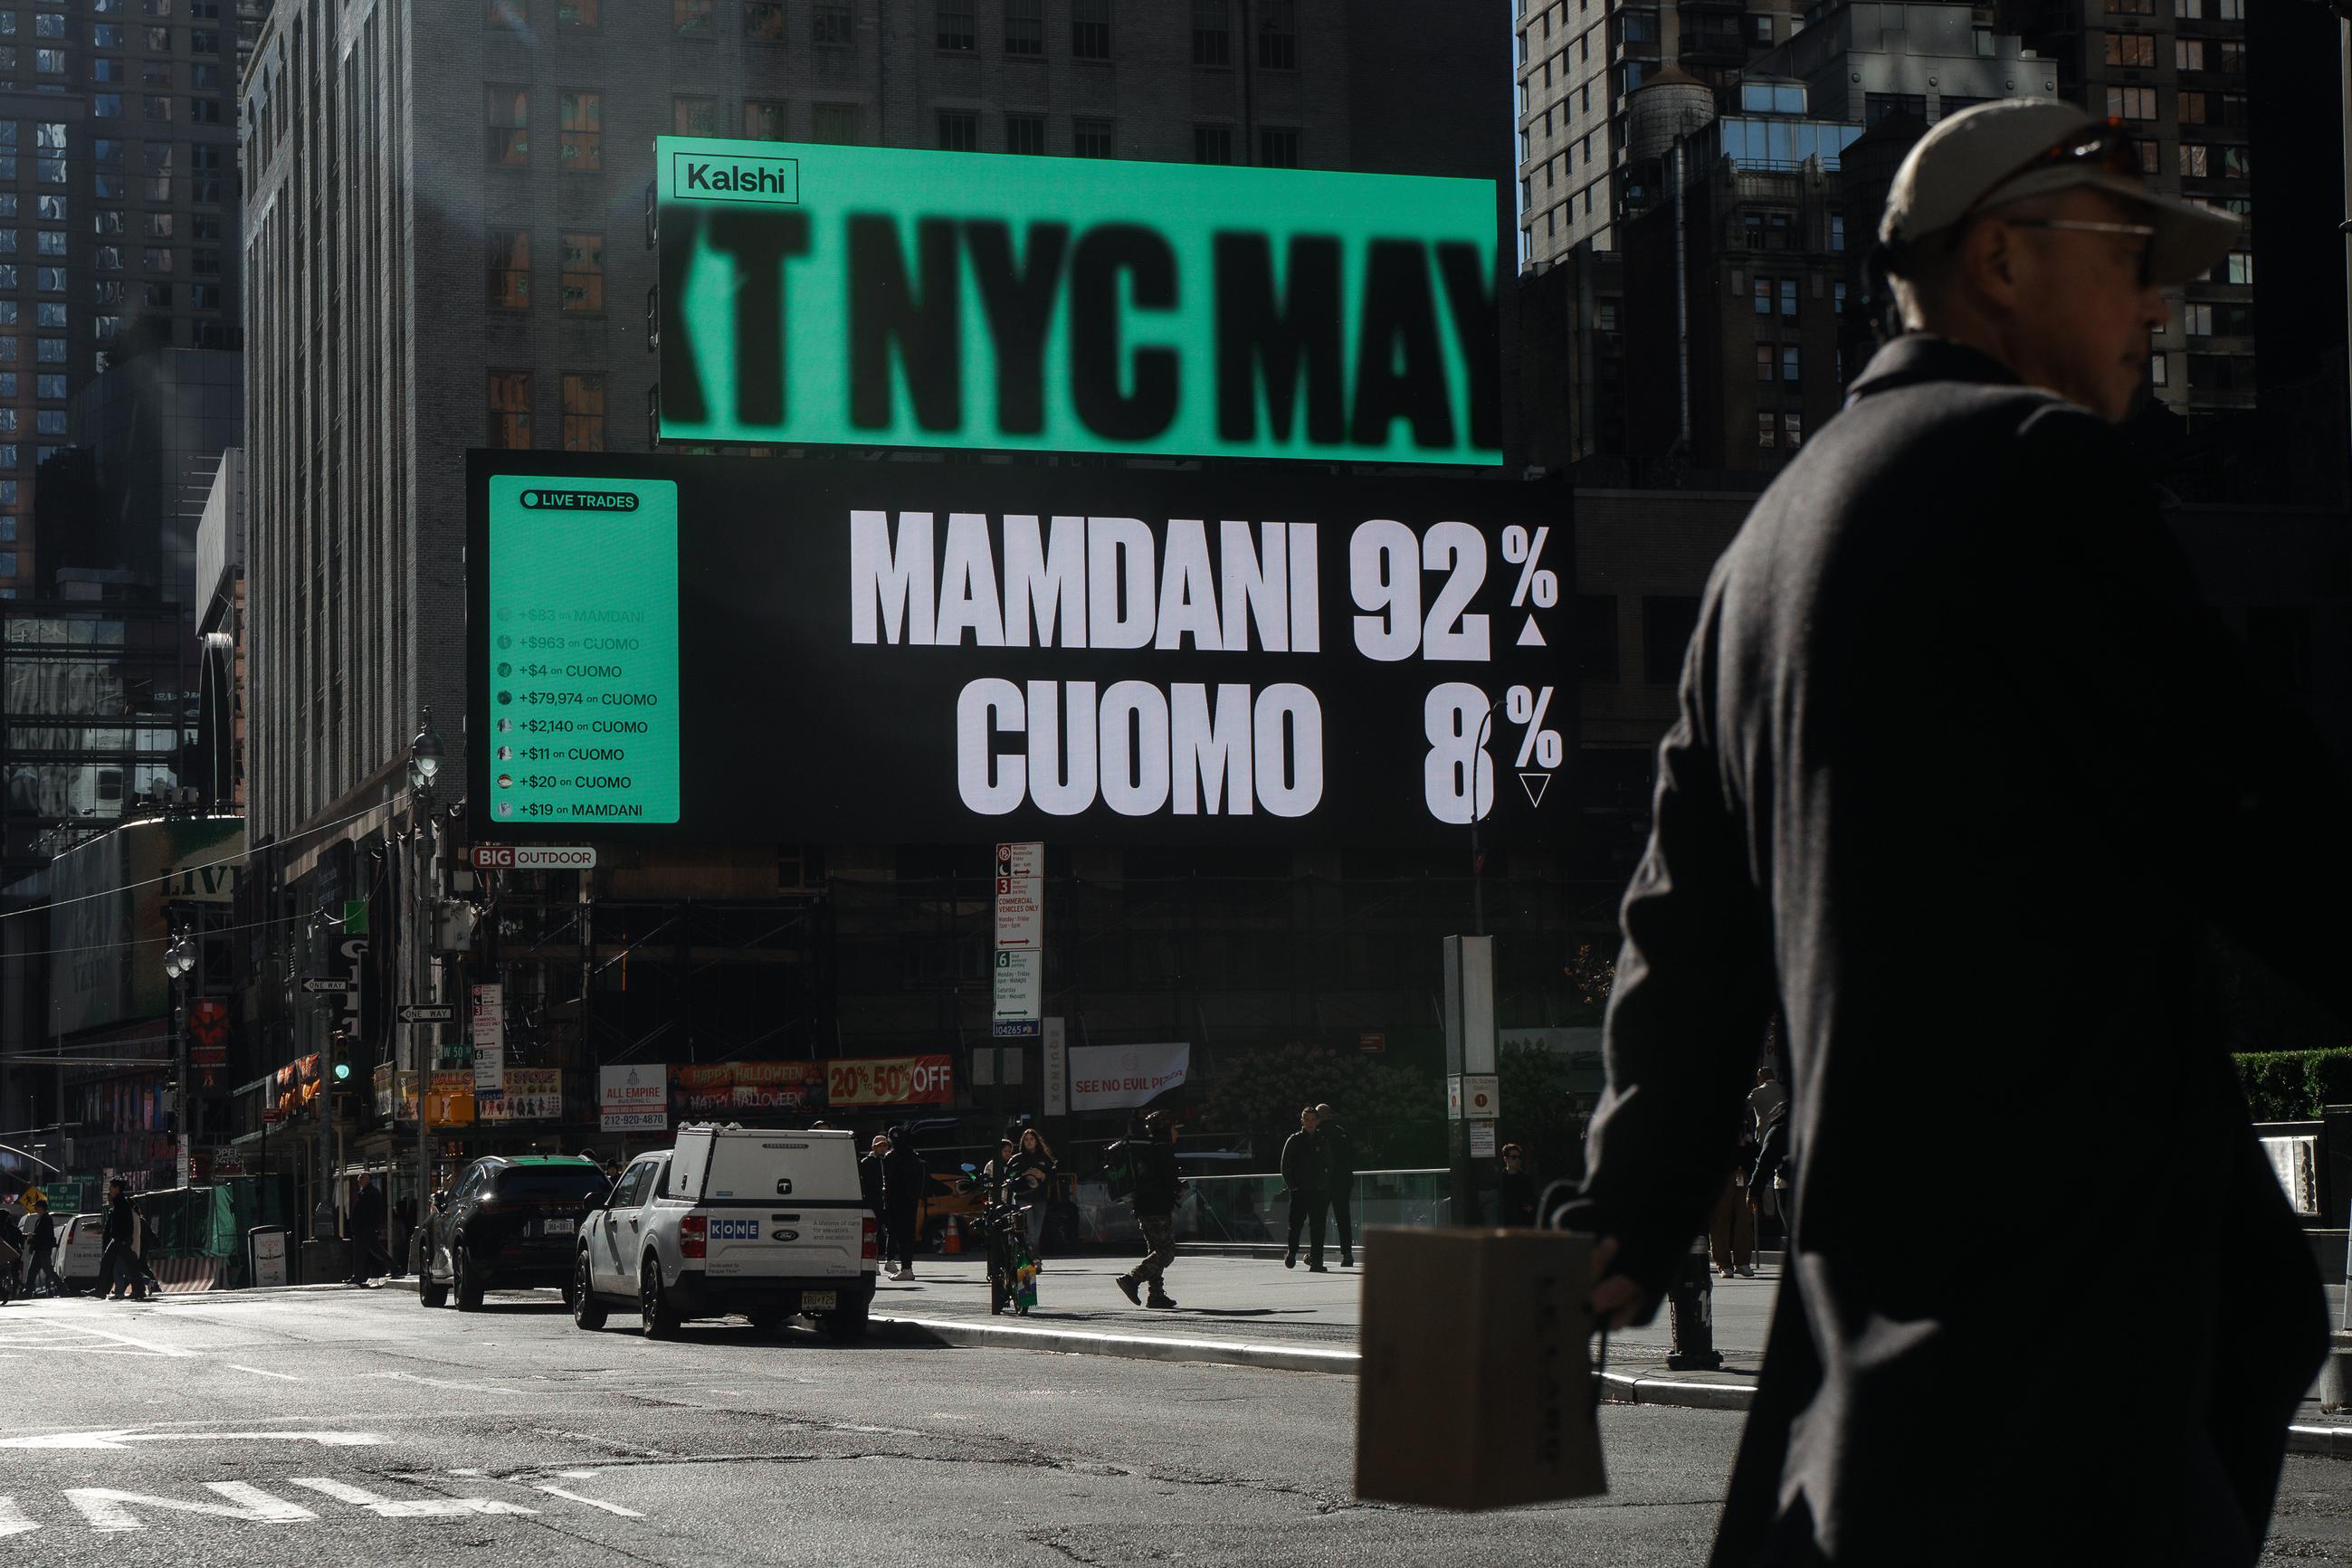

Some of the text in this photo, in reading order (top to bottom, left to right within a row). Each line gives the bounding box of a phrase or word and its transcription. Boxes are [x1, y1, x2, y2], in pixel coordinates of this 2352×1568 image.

[688, 163, 785, 194] Kalshi
[848, 210, 1181, 443] NYC
[543, 494, 634, 508] LIVE TRADES
[851, 510, 1320, 652] MAMDANI
[519, 609, 555, 622] +$83
[574, 611, 644, 622] MAMDANI
[519, 636, 565, 649] +$963
[584, 638, 639, 651] CUOMO
[519, 663, 548, 678] +$4
[567, 665, 622, 678] CUOMO
[519, 691, 583, 706] +$79,974
[602, 694, 657, 706] CUOMO
[519, 718, 573, 734] +$2,140
[592, 721, 648, 733] CUOMO
[519, 746, 549, 761] +$11
[568, 748, 624, 760] CUOMO
[957, 678, 1323, 817] CUOMO
[519, 774, 557, 789] +$20
[575, 775, 631, 788] CUOMO
[520, 802, 553, 816] +$19
[572, 804, 642, 816] MAMDANI
[480, 851, 592, 865] BIG OUTDOOR
[1000, 879, 1008, 893] 3
[999, 953, 1007, 967] 6
[309, 981, 325, 989] ONE
[406, 1010, 448, 1018] ONE WAY
[995, 1025, 1021, 1035] 104265
[443, 1047, 450, 1058] W
[453, 1047, 462, 1058] 50
[514, 1070, 557, 1084] STORE
[693, 1067, 803, 1083] HAPPY HALLOWEEN
[913, 1066, 950, 1092] OFF
[607, 1087, 661, 1098] ALL EMPIRE
[1076, 1080, 1099, 1093] SEE
[1102, 1079, 1119, 1092] NO
[1124, 1079, 1148, 1090] EVIL
[733, 1092, 802, 1108] HALLOWEEN
[605, 1114, 663, 1125] 212-920-4870
[712, 1224, 757, 1235] KONE
